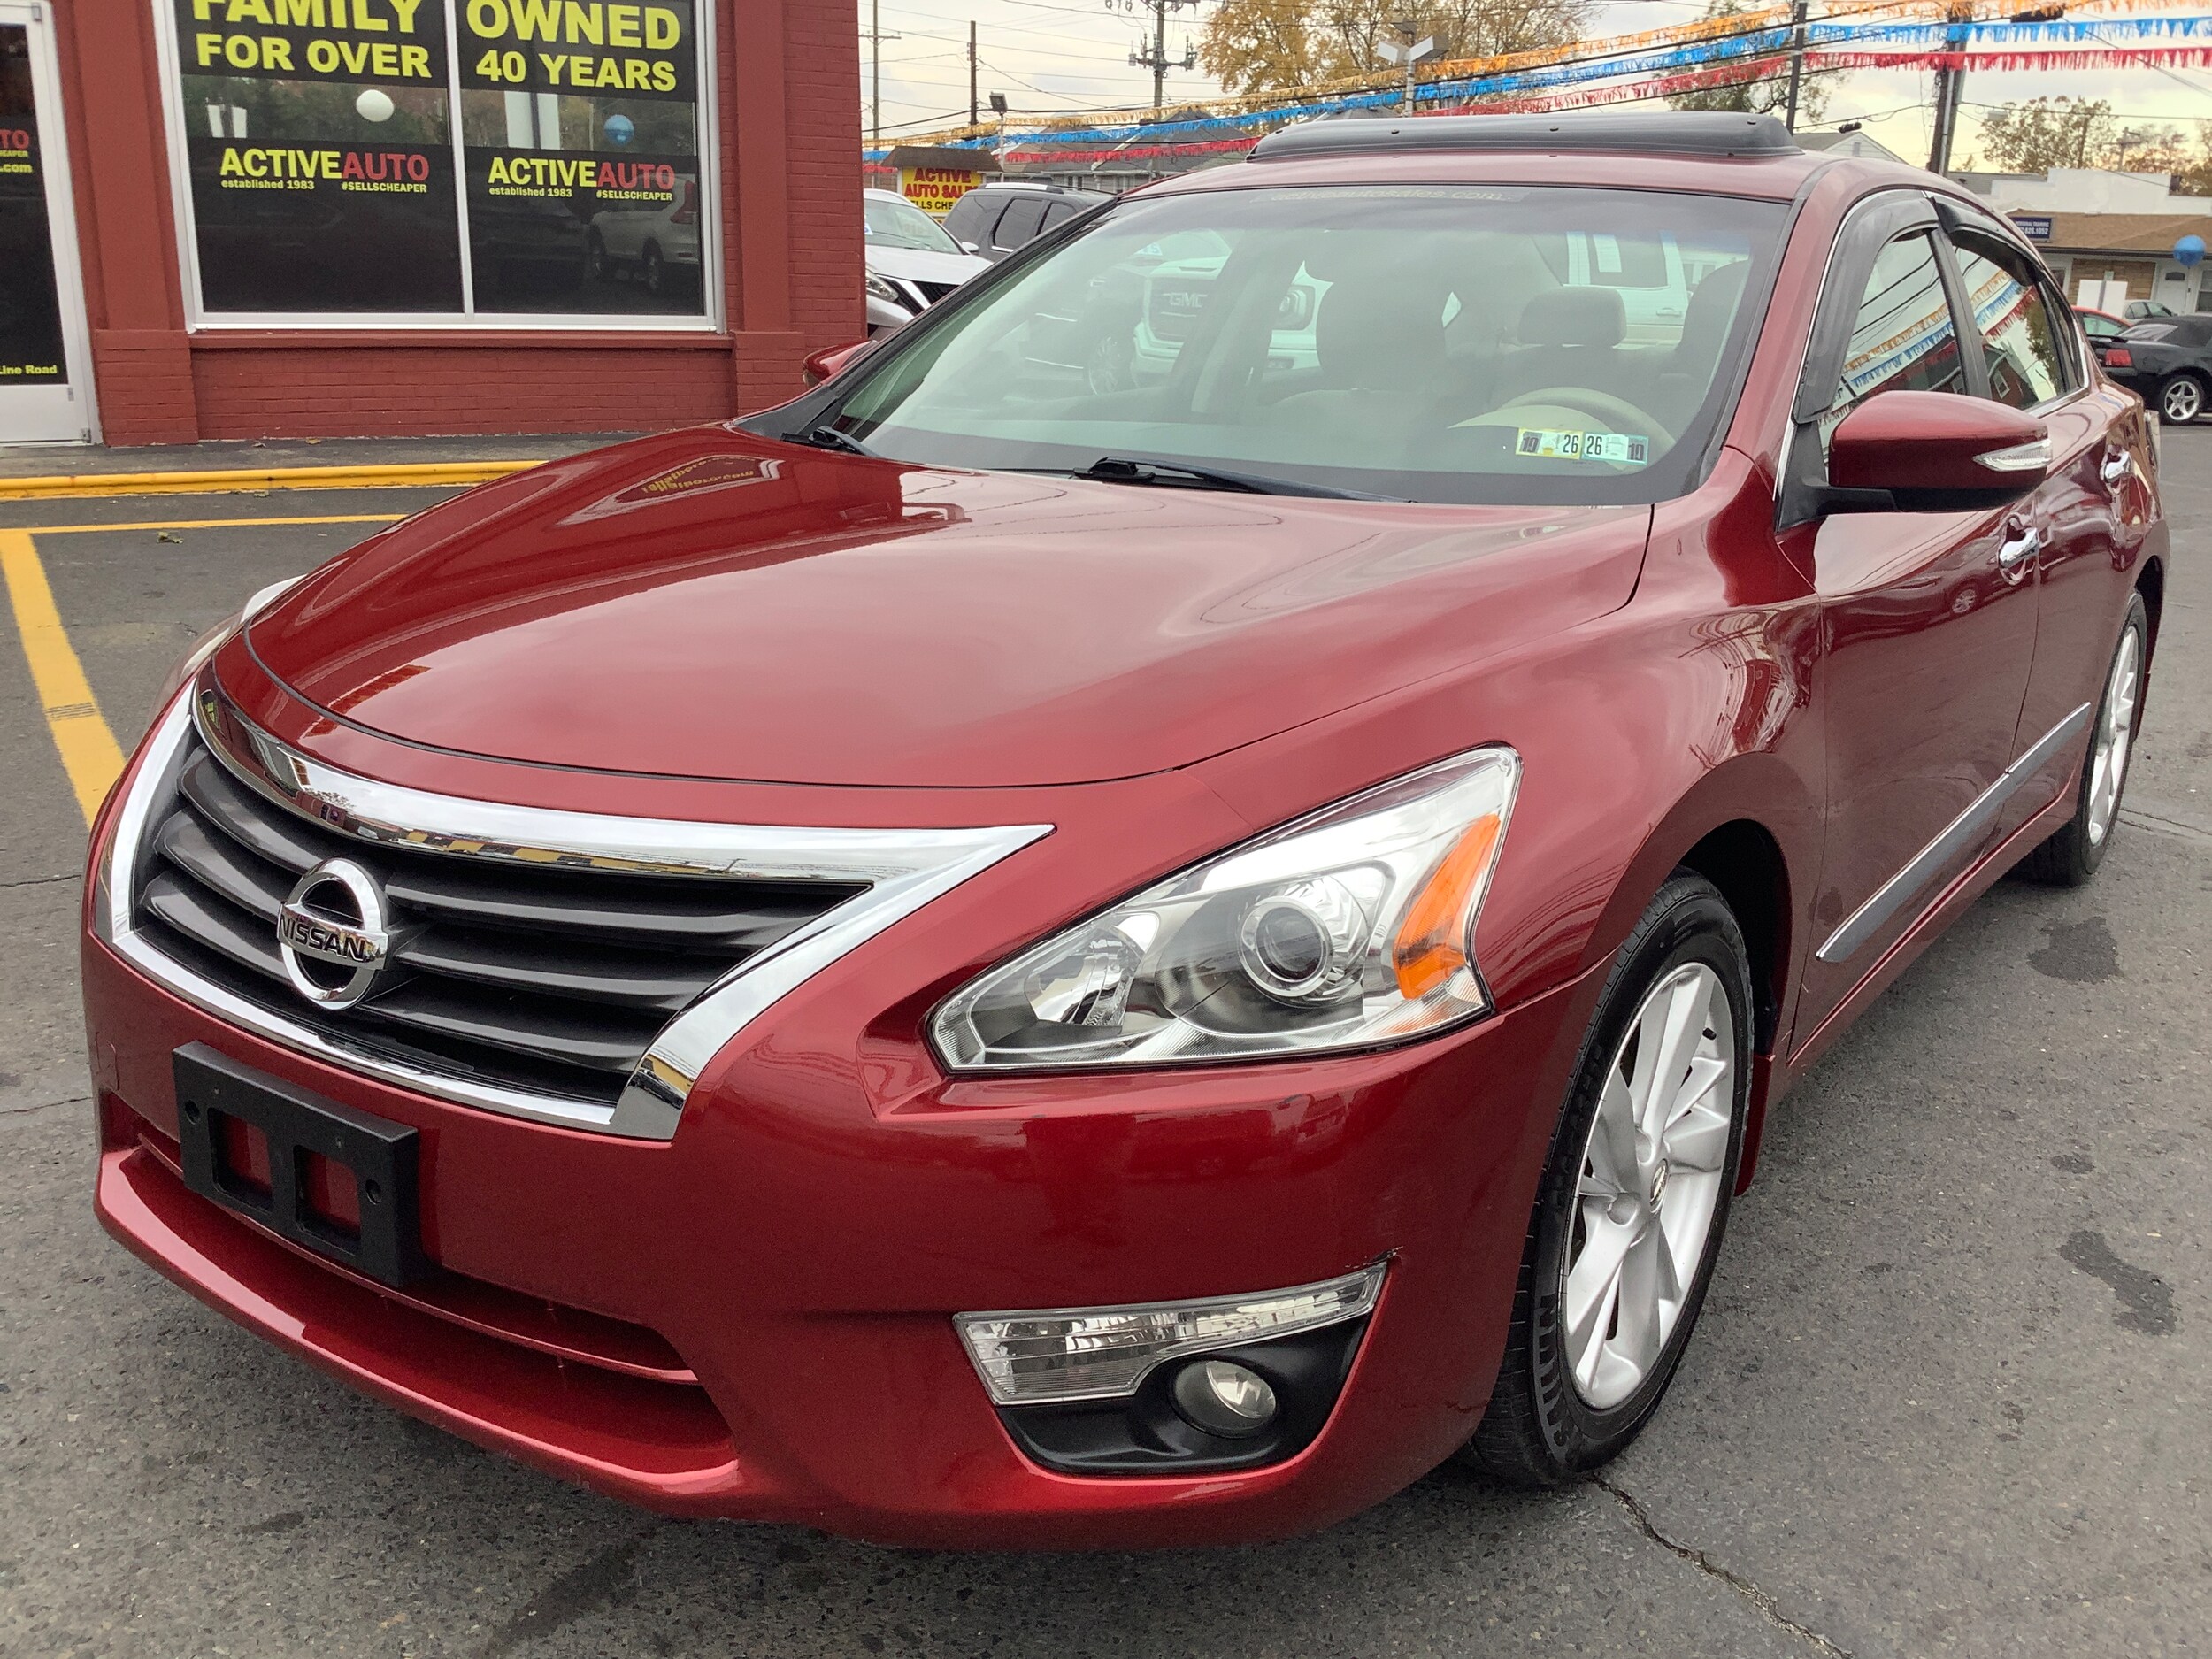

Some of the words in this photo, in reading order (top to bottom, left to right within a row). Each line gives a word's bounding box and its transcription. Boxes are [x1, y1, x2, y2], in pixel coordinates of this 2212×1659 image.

[466, 0, 680, 50] OWNED
[196, 33, 295, 71] FOR
[307, 39, 432, 78] OVER
[476, 50, 526, 83] 40
[538, 53, 677, 92] YEARS
[913, 167, 972, 184] ACTIVE
[221, 180, 283, 189] established
[287, 180, 315, 190] 1983
[342, 181, 427, 193] #SELLSCHEAPER
[489, 187, 545, 196] established
[547, 188, 573, 197] 1983
[904, 183, 940, 198] AUTO
[941, 184, 978, 198] SAL
[596, 189, 672, 201] #SELLSCHEAPER
[1169, 292, 1208, 308] GMC
[0, 365, 22, 374] ine
[25, 365, 58, 374] Road
[1563, 434, 1579, 454] 26
[1586, 435, 1603, 456] 26
[279, 913, 366, 962] NISSAN
